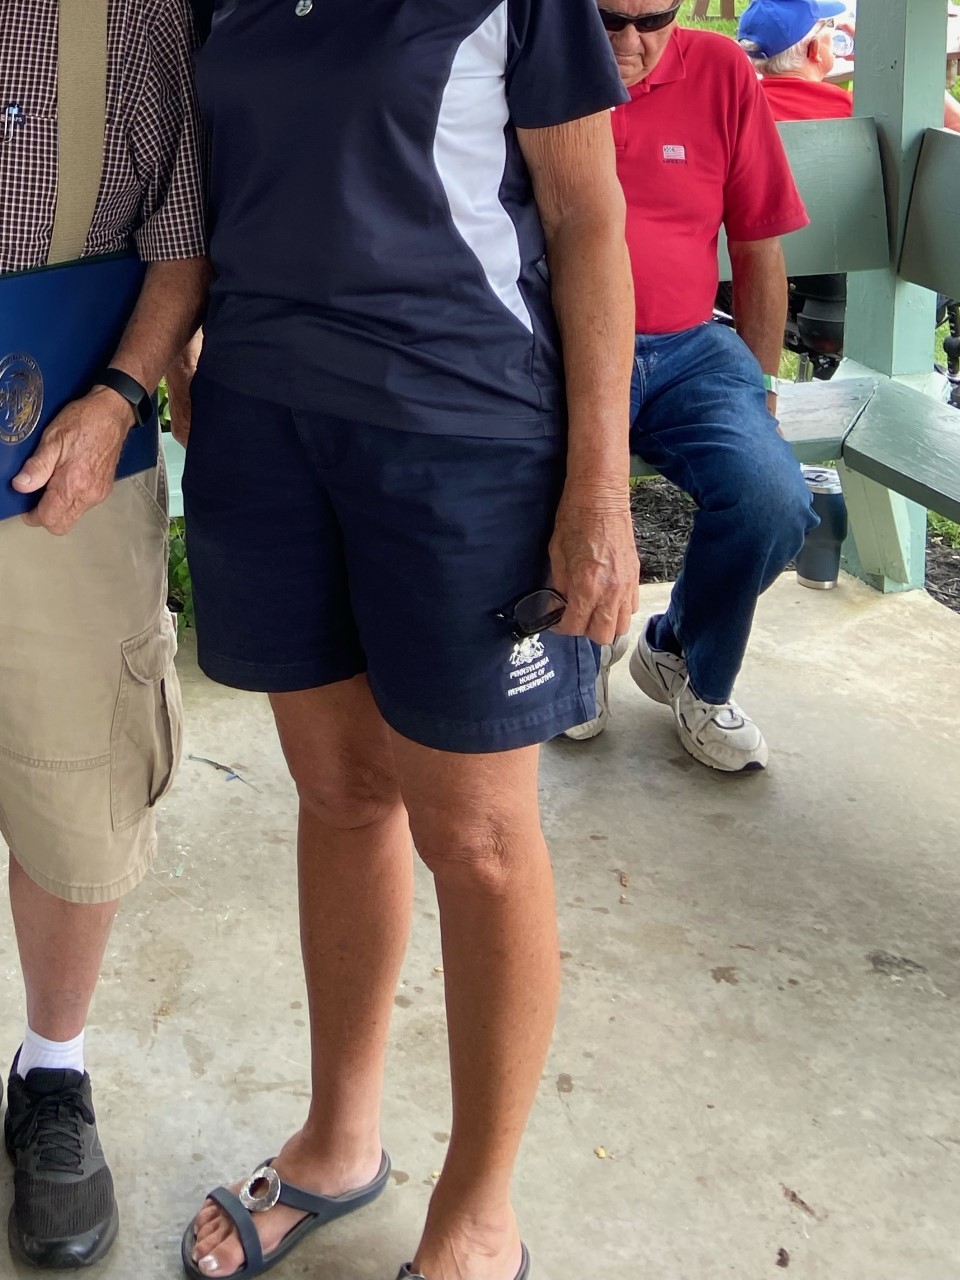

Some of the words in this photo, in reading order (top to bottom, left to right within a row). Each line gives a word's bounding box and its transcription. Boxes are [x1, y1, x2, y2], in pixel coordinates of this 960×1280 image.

[509, 656, 550, 680] PENNSYLVANIA
[519, 671, 538, 685] HOUSE
[538, 667, 546, 676] OF
[507, 670, 556, 697] REPRESENTATIVES
